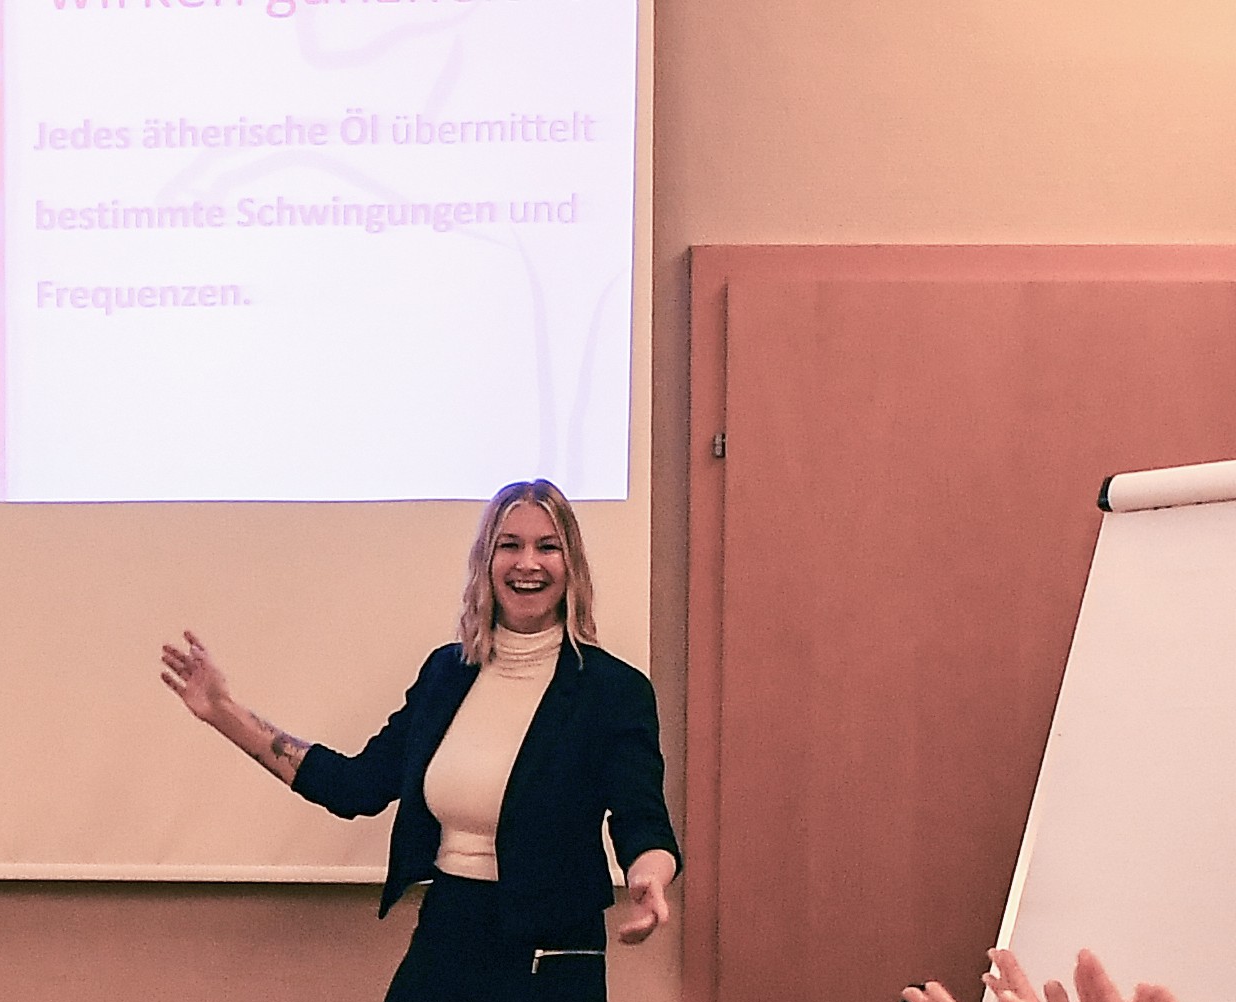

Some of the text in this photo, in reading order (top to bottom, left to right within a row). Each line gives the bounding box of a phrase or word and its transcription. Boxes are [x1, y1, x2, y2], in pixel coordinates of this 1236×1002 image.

[33, 108, 598, 150] Jedes ätherische Öl übermittelt
[36, 192, 579, 234] bestimmte Schwingungen und
[36, 280, 254, 316] Frequenzen.
